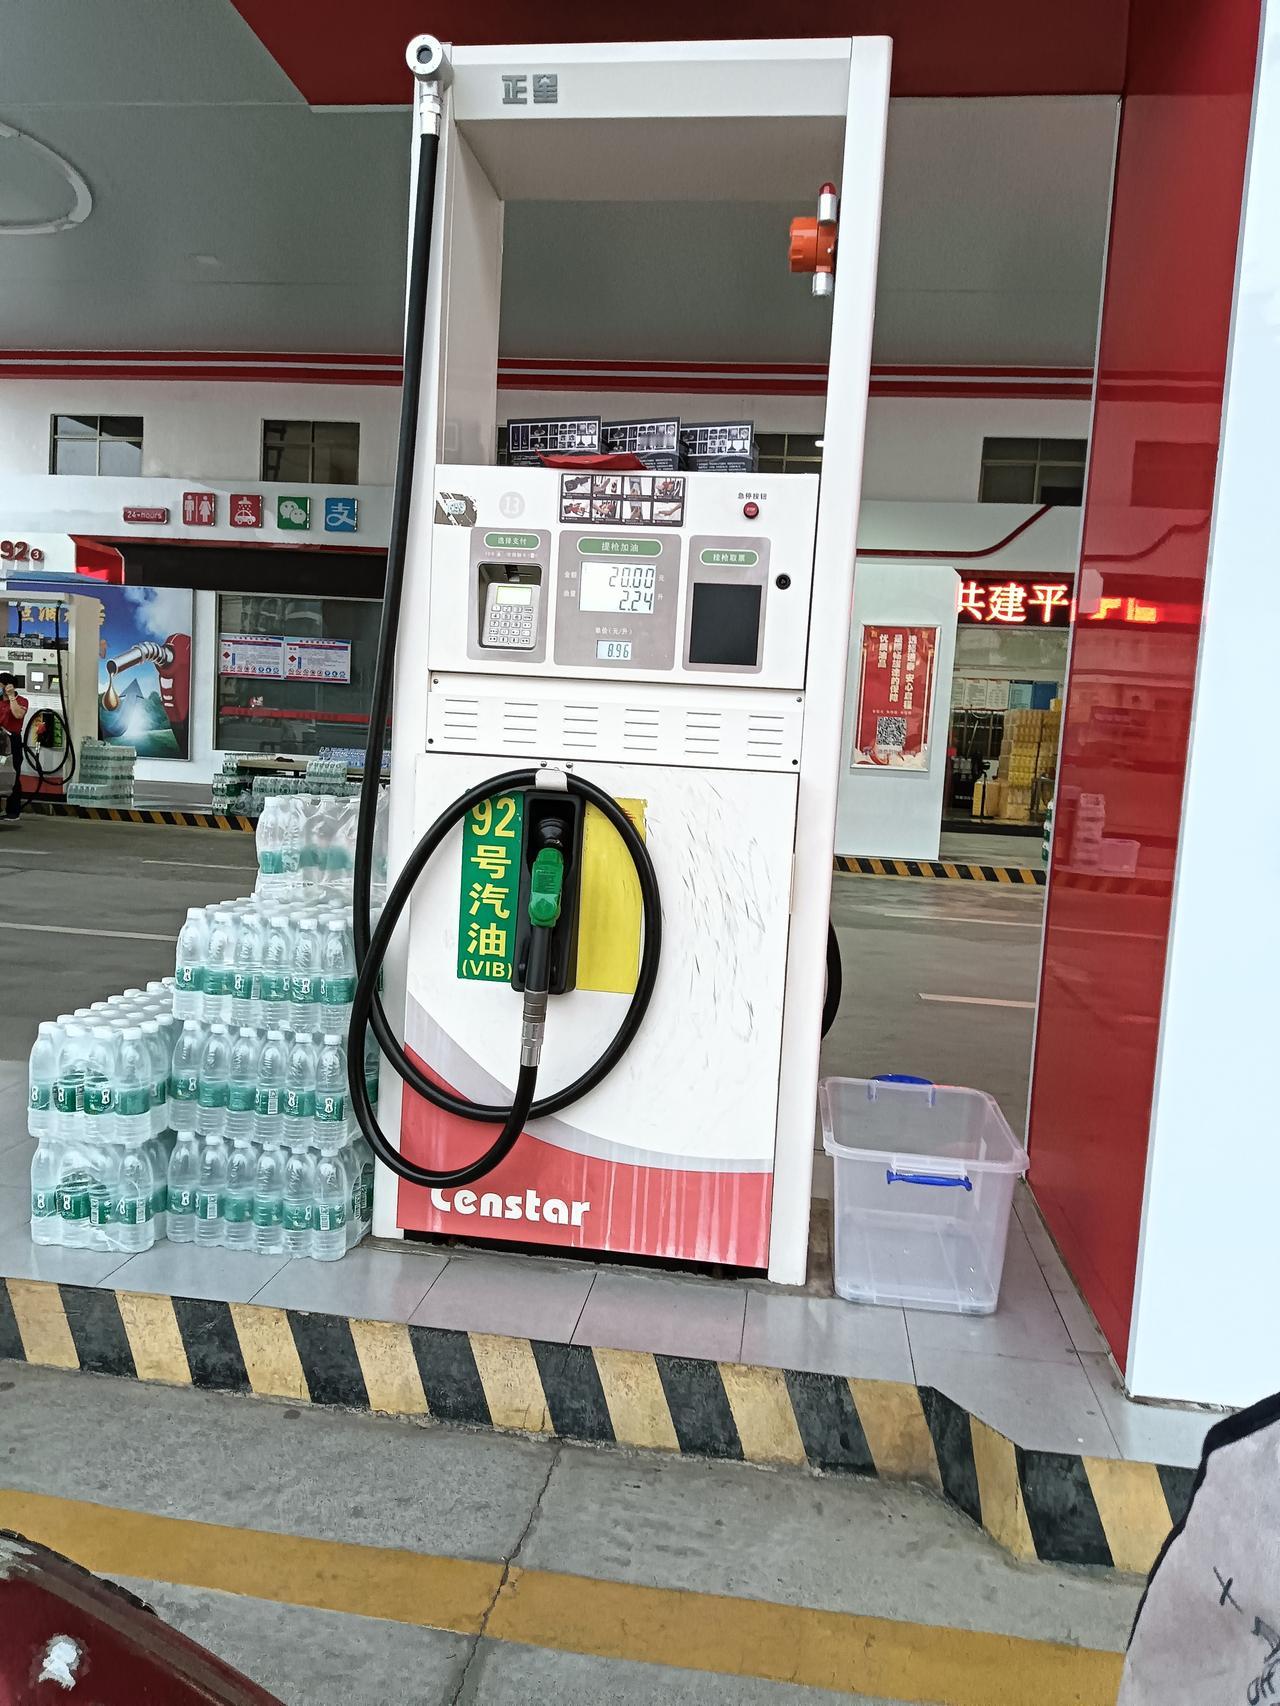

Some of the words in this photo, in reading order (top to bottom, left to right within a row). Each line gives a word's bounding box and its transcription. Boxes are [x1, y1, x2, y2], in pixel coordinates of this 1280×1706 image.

[0, 540, 28, 561] 92
[601, 541, 639, 552] 提枪加油
[609, 566, 654, 588] 20.00
[619, 590, 653, 611] 2.24
[607, 643, 629, 658] 8.96
[471, 796, 516, 837] 92
[430, 1188, 591, 1227] Censtar
